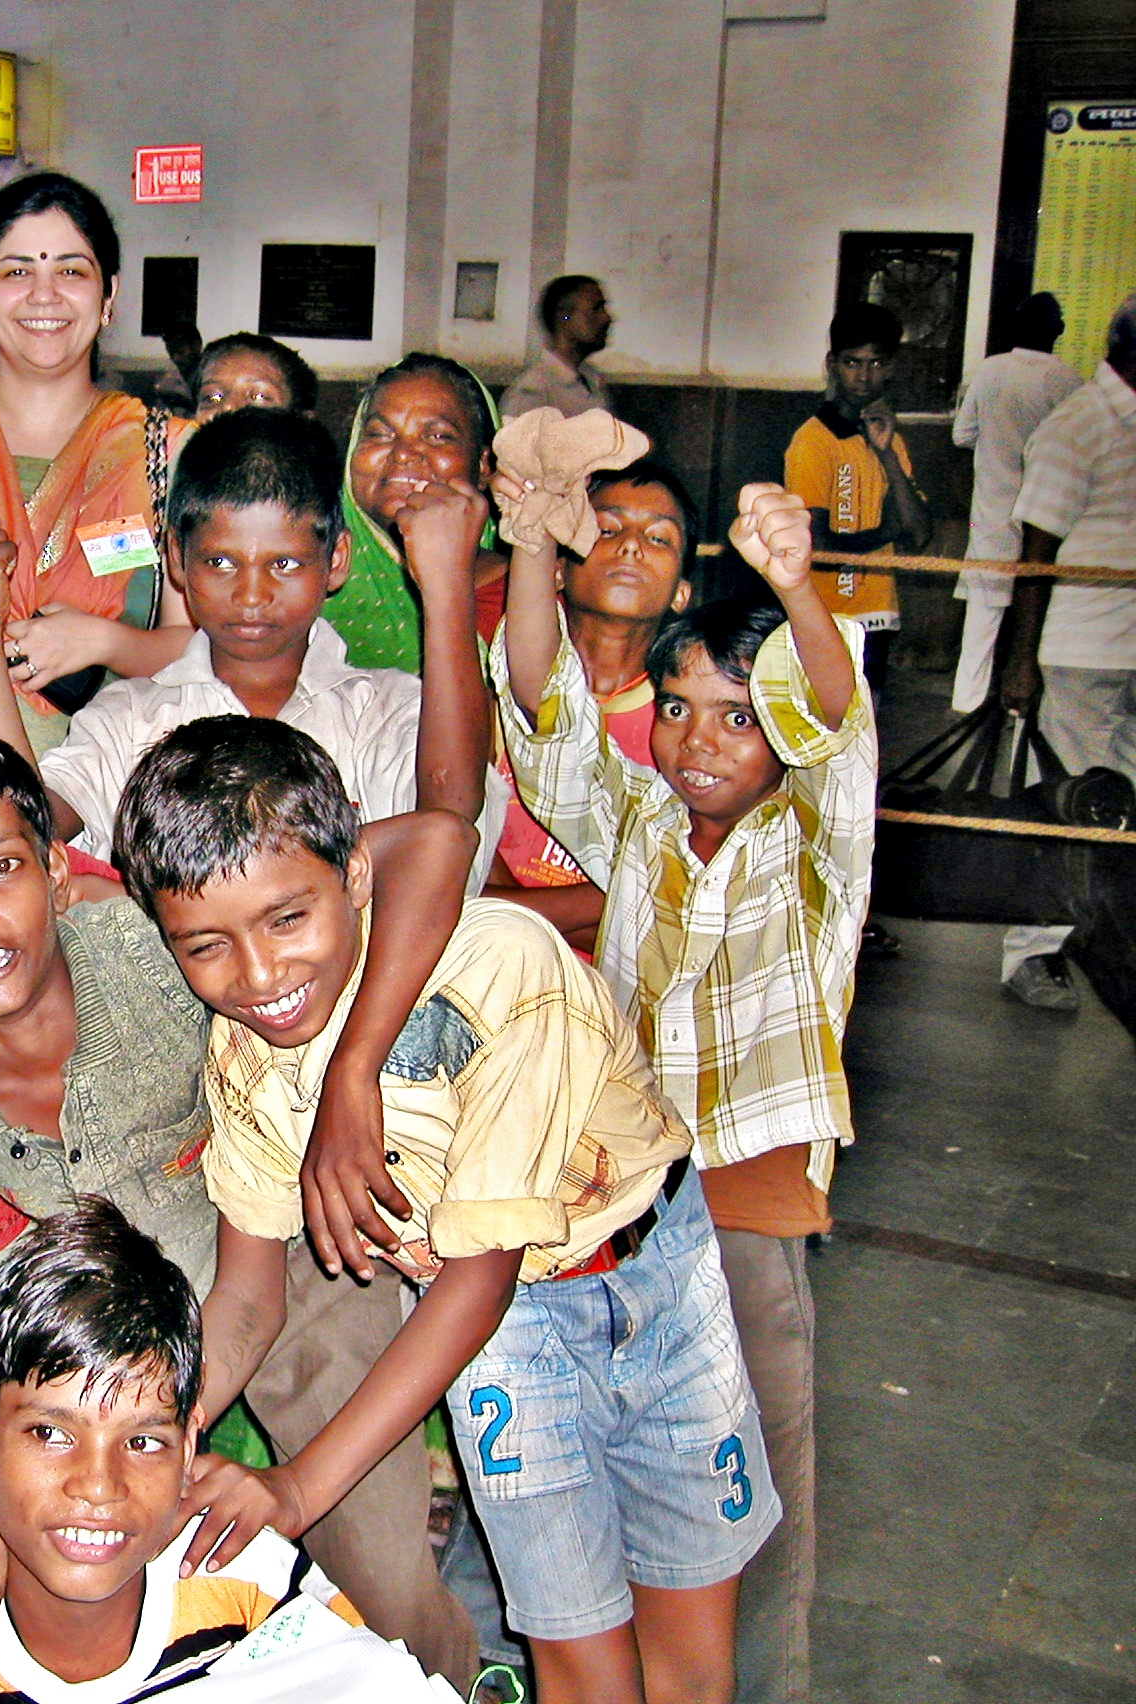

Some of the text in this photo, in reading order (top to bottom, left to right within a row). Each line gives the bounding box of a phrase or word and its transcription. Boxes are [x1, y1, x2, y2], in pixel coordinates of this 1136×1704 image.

[159, 171, 179, 185] USE
[838, 463, 853, 522] JEANS
[467, 1382, 526, 1476] 2
[710, 1432, 755, 1525] 3
